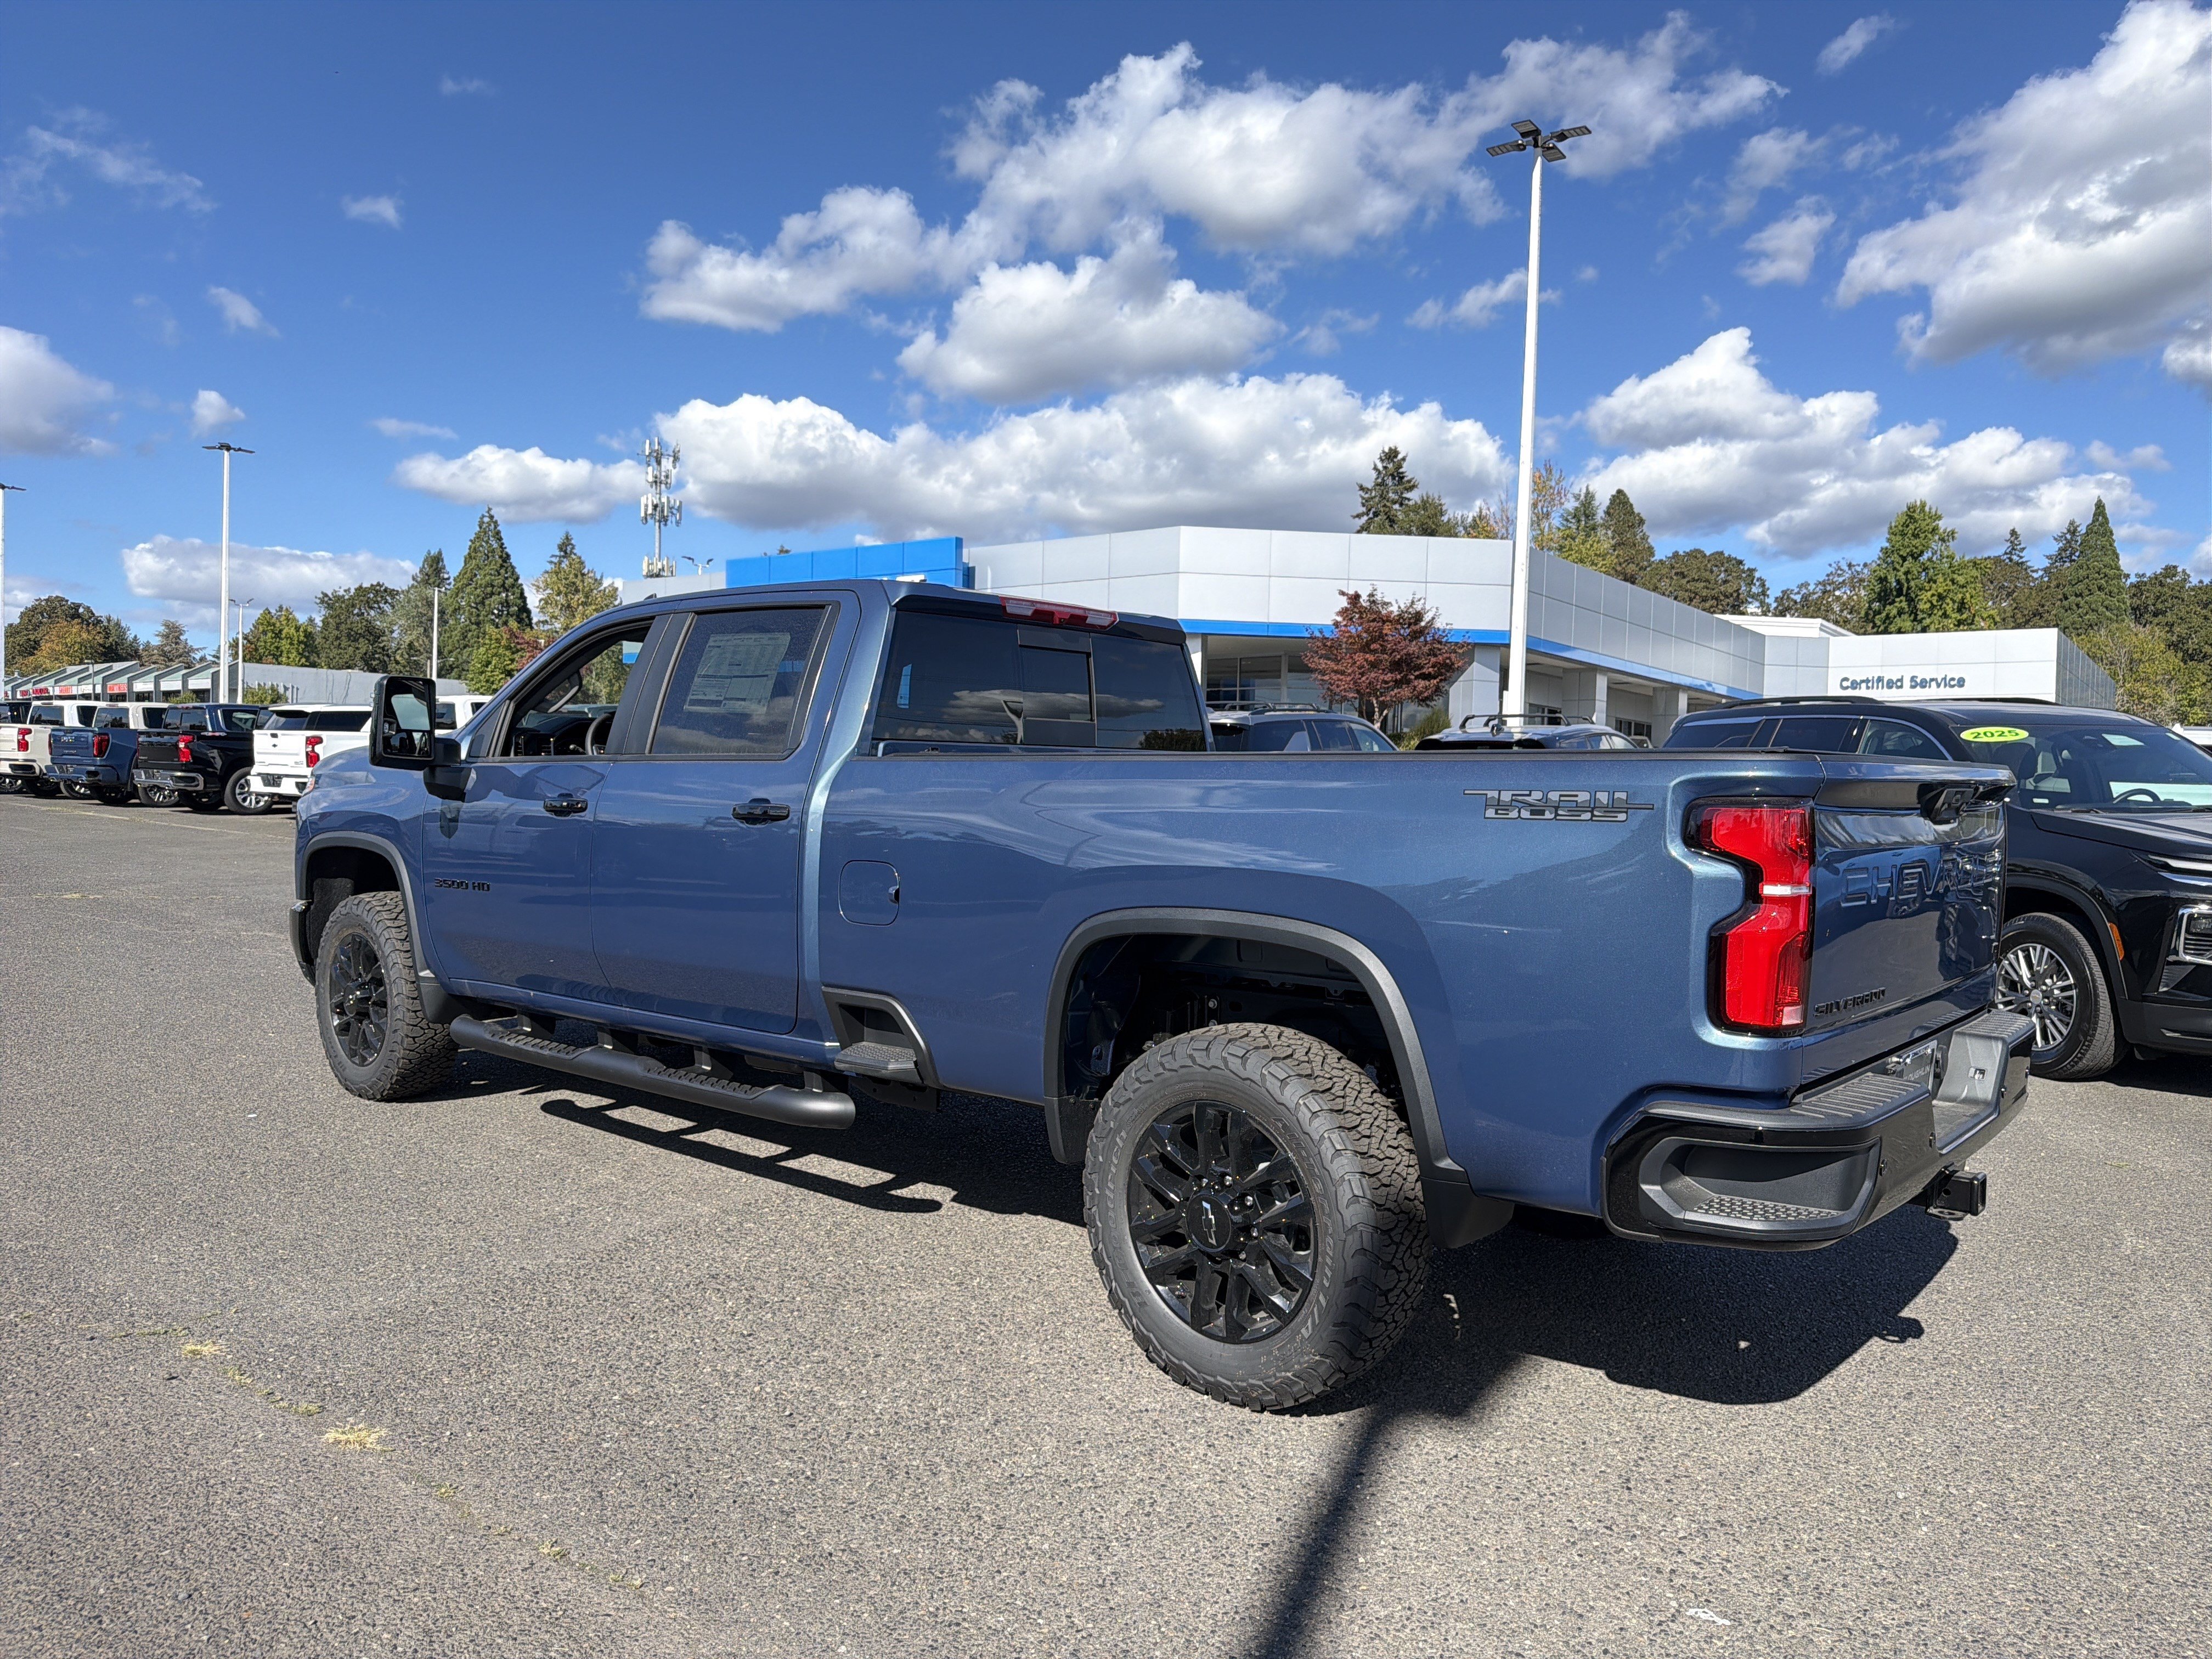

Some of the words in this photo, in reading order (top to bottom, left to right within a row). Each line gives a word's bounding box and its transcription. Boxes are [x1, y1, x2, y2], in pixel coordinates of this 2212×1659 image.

[1839, 675, 1904, 690] Certified
[1909, 675, 1966, 689] Service
[1971, 730, 2021, 740] 2025
[1463, 789, 1655, 811] TRAIL
[1483, 805, 1628, 823] BOSS
[434, 878, 469, 890] 3500
[472, 881, 490, 891] HD
